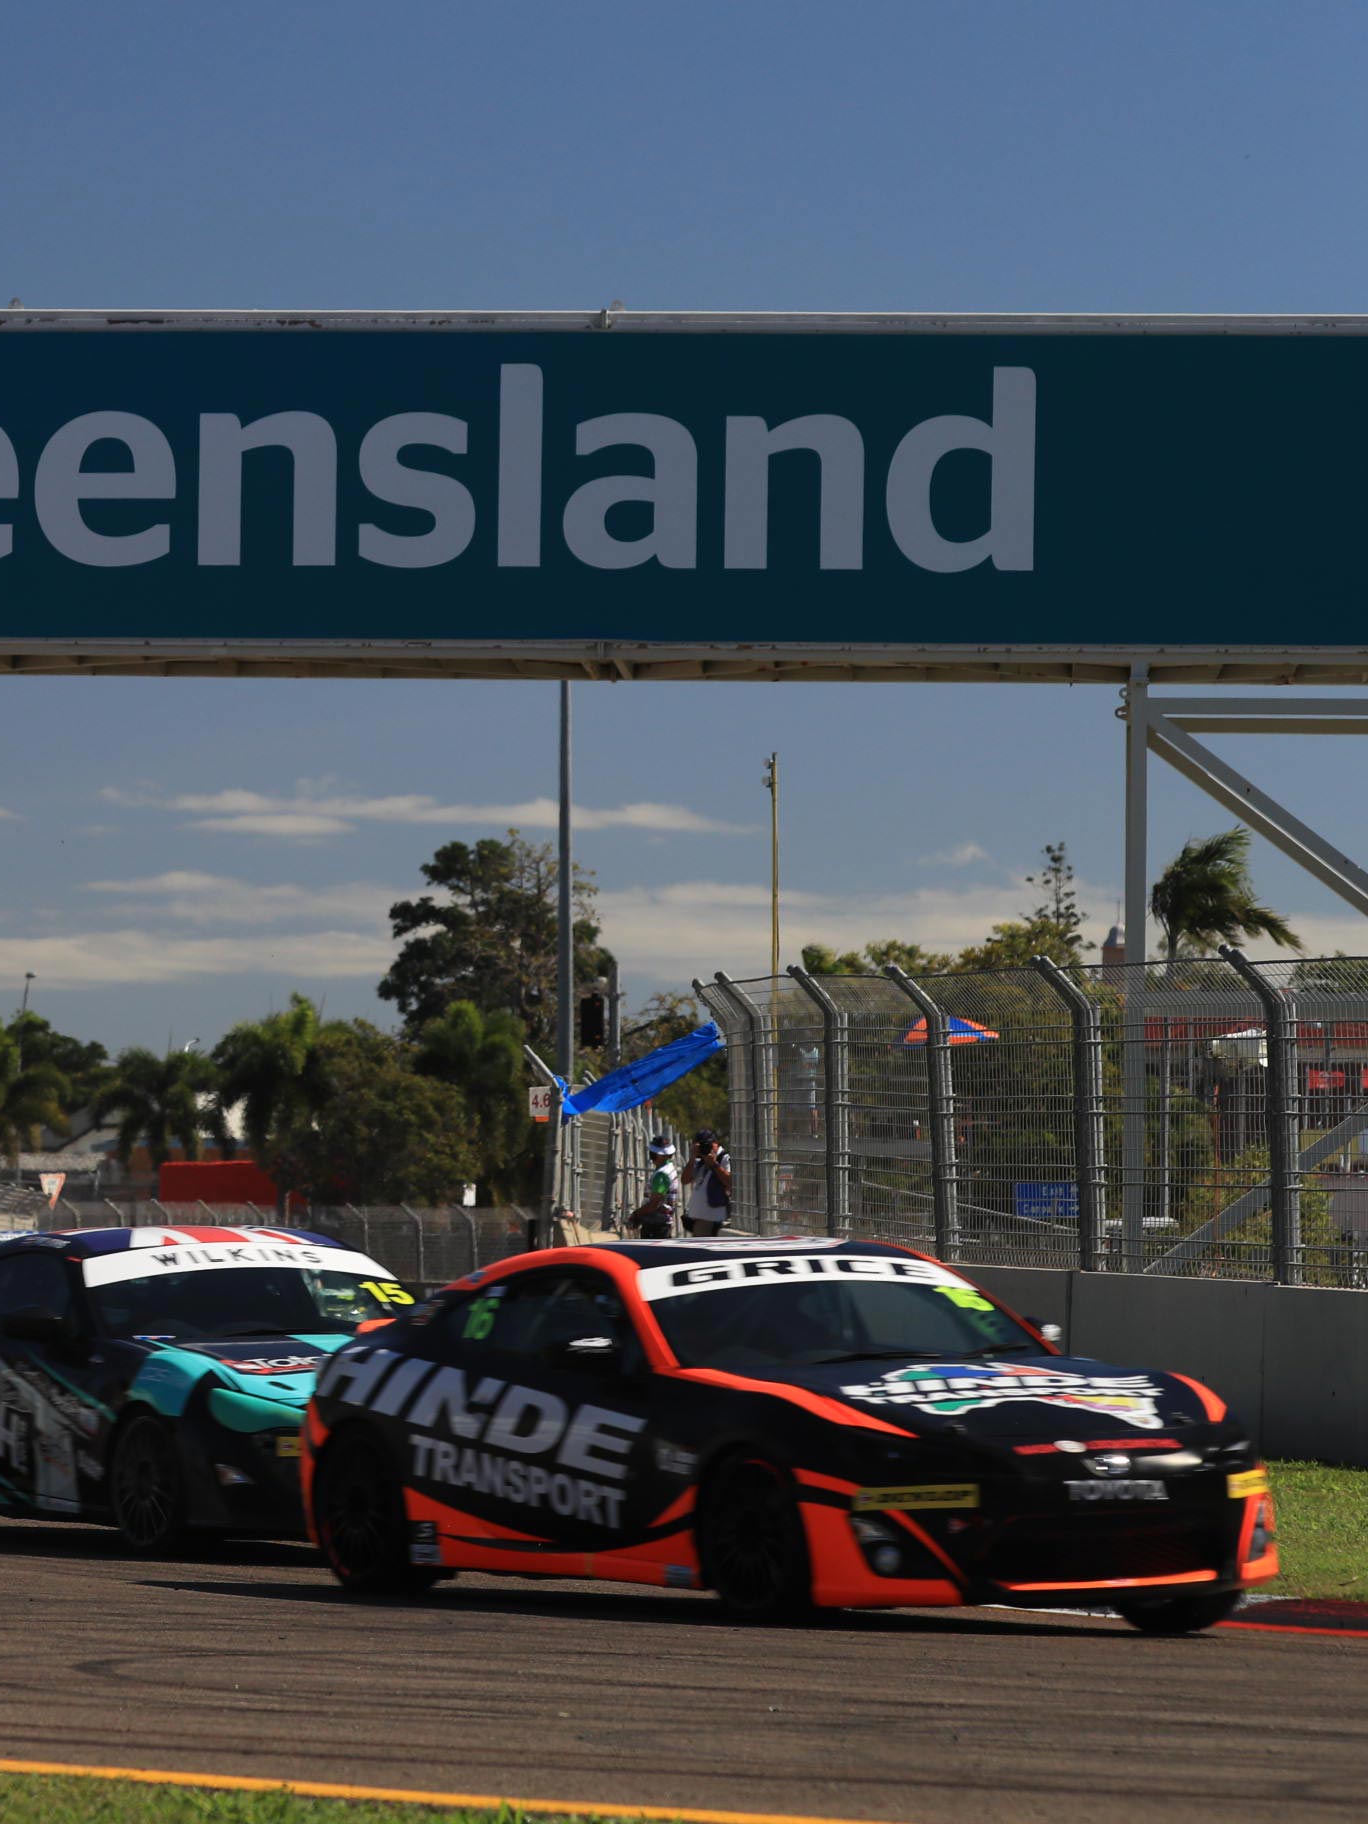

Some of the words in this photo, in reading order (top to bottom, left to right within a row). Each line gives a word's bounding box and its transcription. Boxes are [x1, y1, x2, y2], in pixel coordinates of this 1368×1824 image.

[151, 1248, 322, 1268] WILKINS
[671, 1257, 934, 1287] GRICE
[359, 1281, 416, 1305] 15
[840, 1375, 1155, 1400] HINDE
[317, 1346, 648, 1480] HINDE
[409, 1433, 627, 1530] TRANSPORT
[1064, 1479, 1169, 1500] TOYOTA
